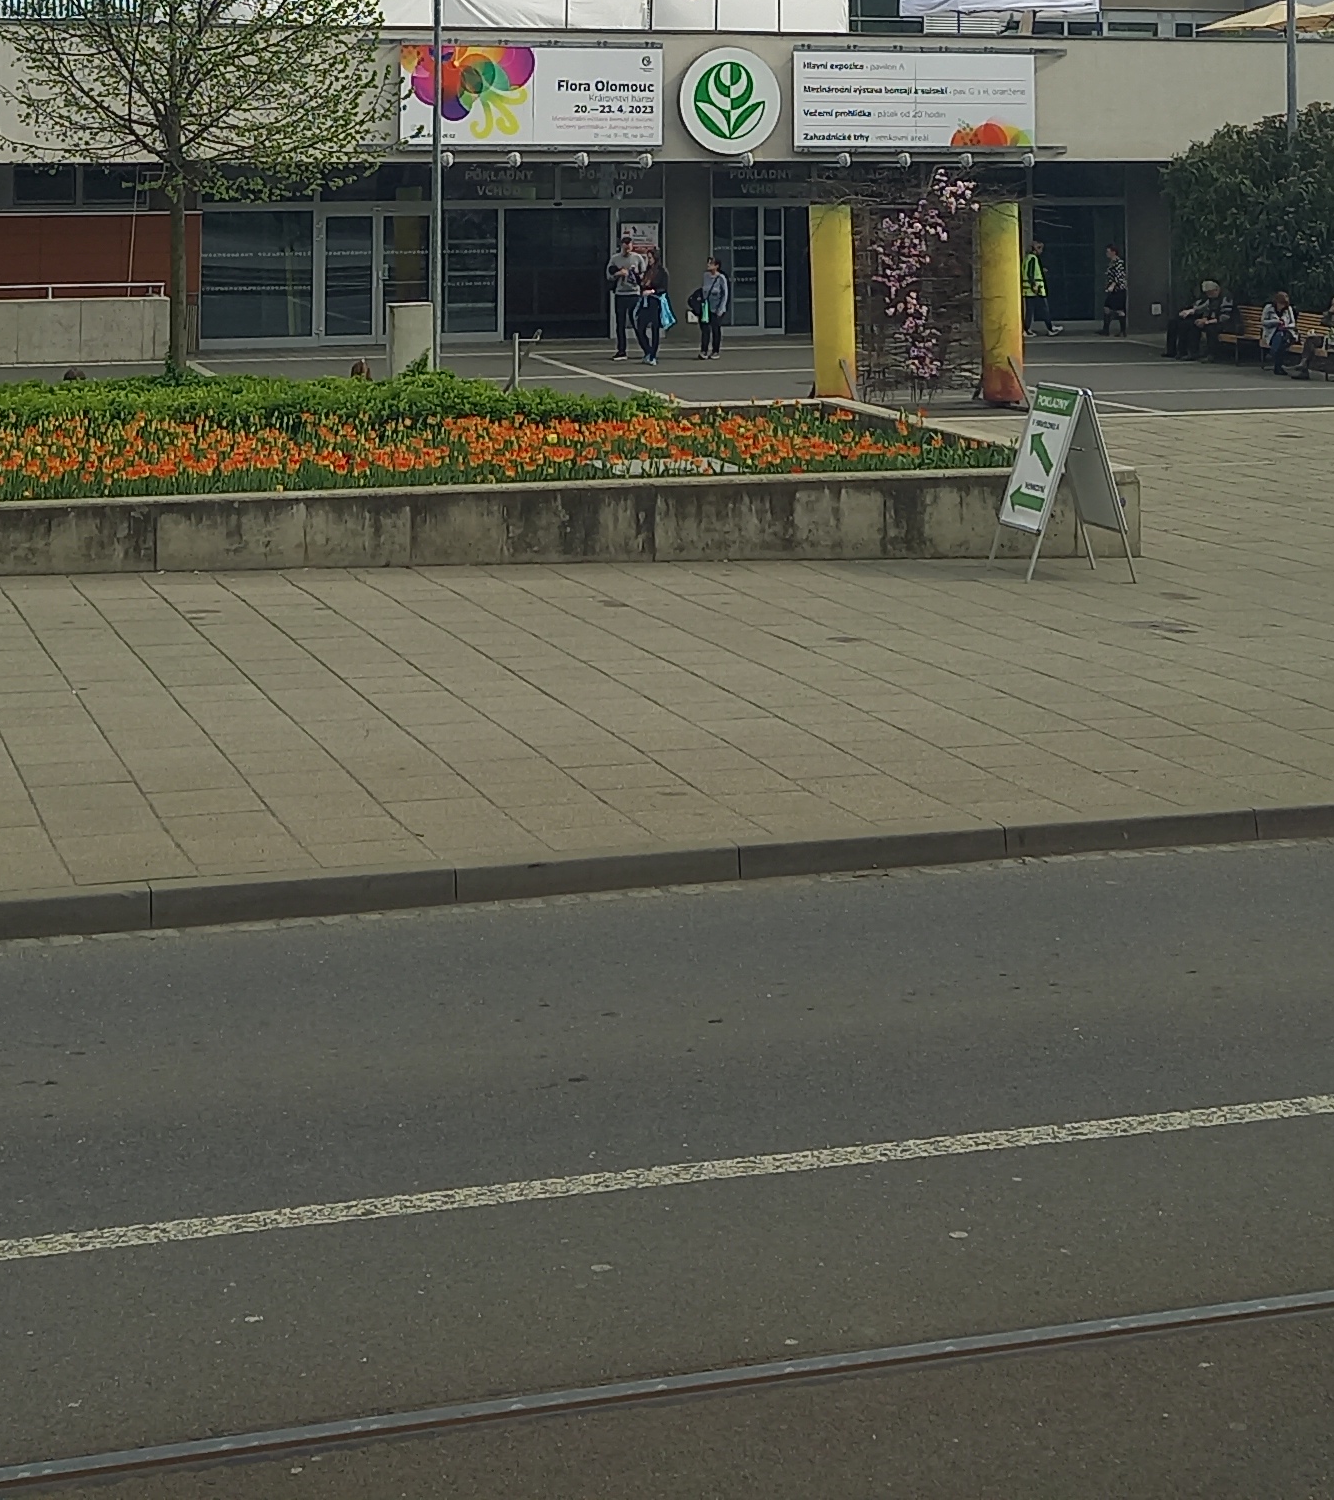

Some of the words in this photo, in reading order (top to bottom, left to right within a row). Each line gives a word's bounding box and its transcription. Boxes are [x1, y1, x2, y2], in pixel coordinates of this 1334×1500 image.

[557, 80, 591, 92] Flora
[595, 80, 654, 92] Olomouc
[588, 94, 628, 102] Království
[629, 105, 654, 114] 2023
[853, 133, 869, 142] trhy
